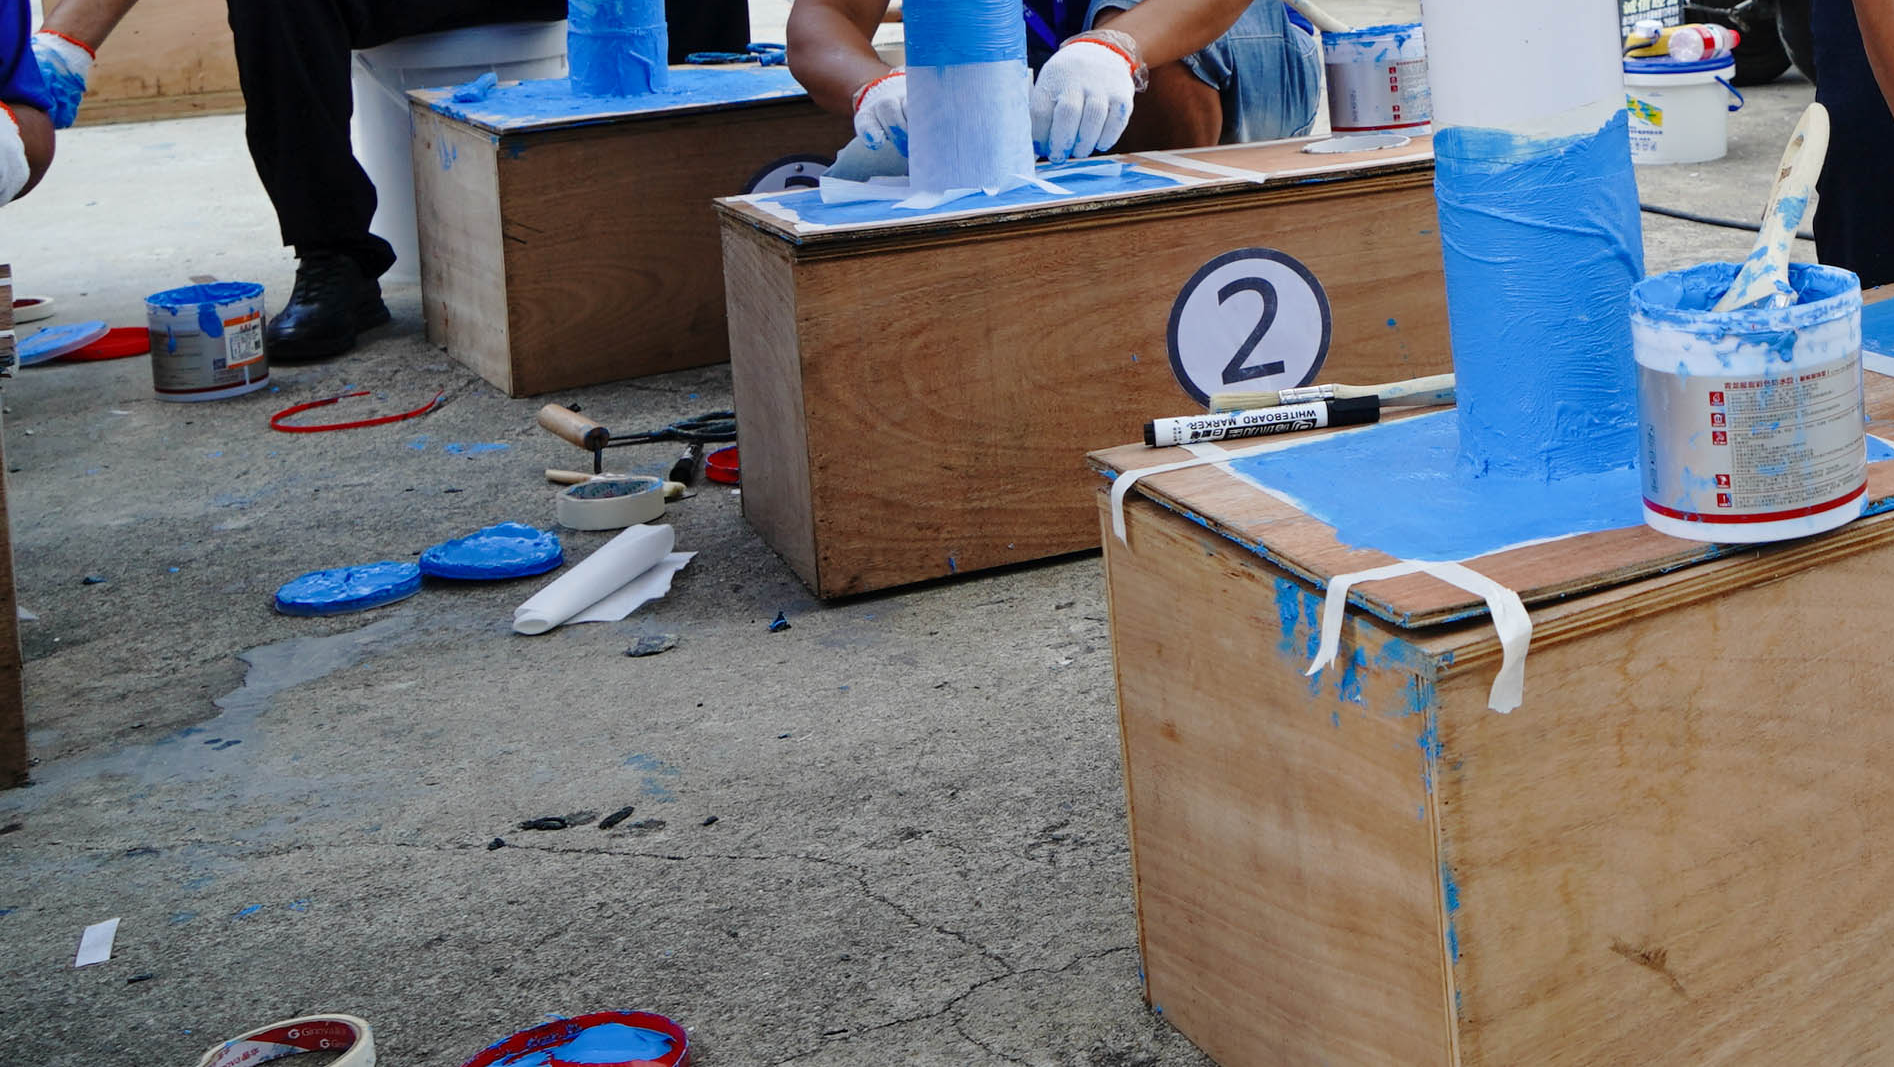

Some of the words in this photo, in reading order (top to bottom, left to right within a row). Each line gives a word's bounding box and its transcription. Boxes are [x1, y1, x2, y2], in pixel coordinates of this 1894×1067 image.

[1218, 277, 1285, 385] 2
[1191, 416, 1237, 430] MARKER
[1243, 409, 1317, 425] WHITEBOARD
